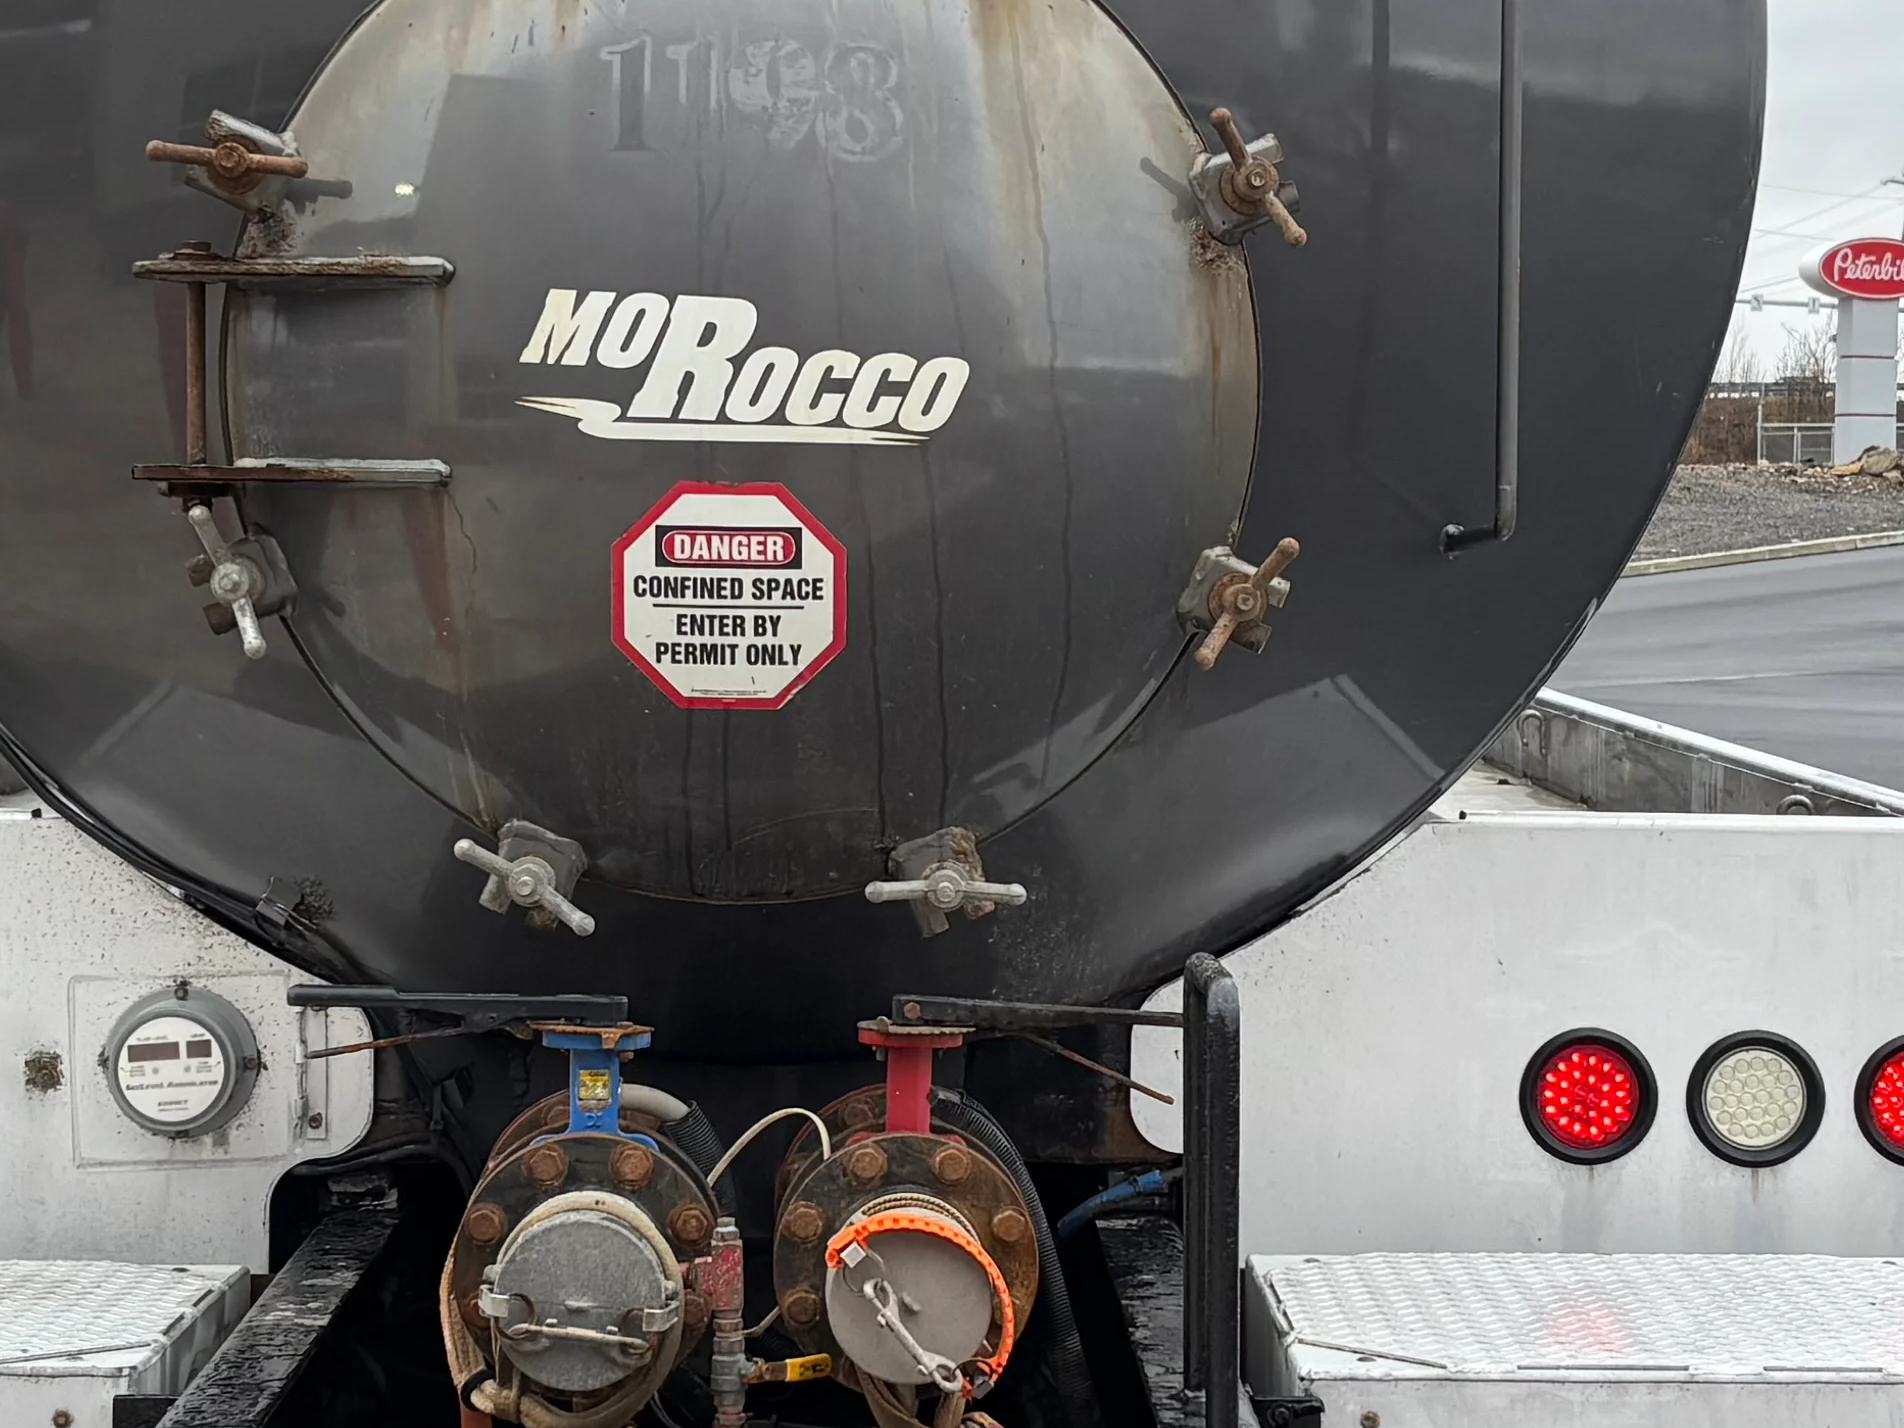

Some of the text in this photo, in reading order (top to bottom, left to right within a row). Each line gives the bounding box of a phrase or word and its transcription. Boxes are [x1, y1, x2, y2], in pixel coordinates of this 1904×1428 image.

[673, 534, 785, 562] DANGER
[633, 575, 824, 601] CONFINED SPACE
[676, 613, 782, 638] ENTER BY
[655, 642, 803, 666] PERMIT ONLY
